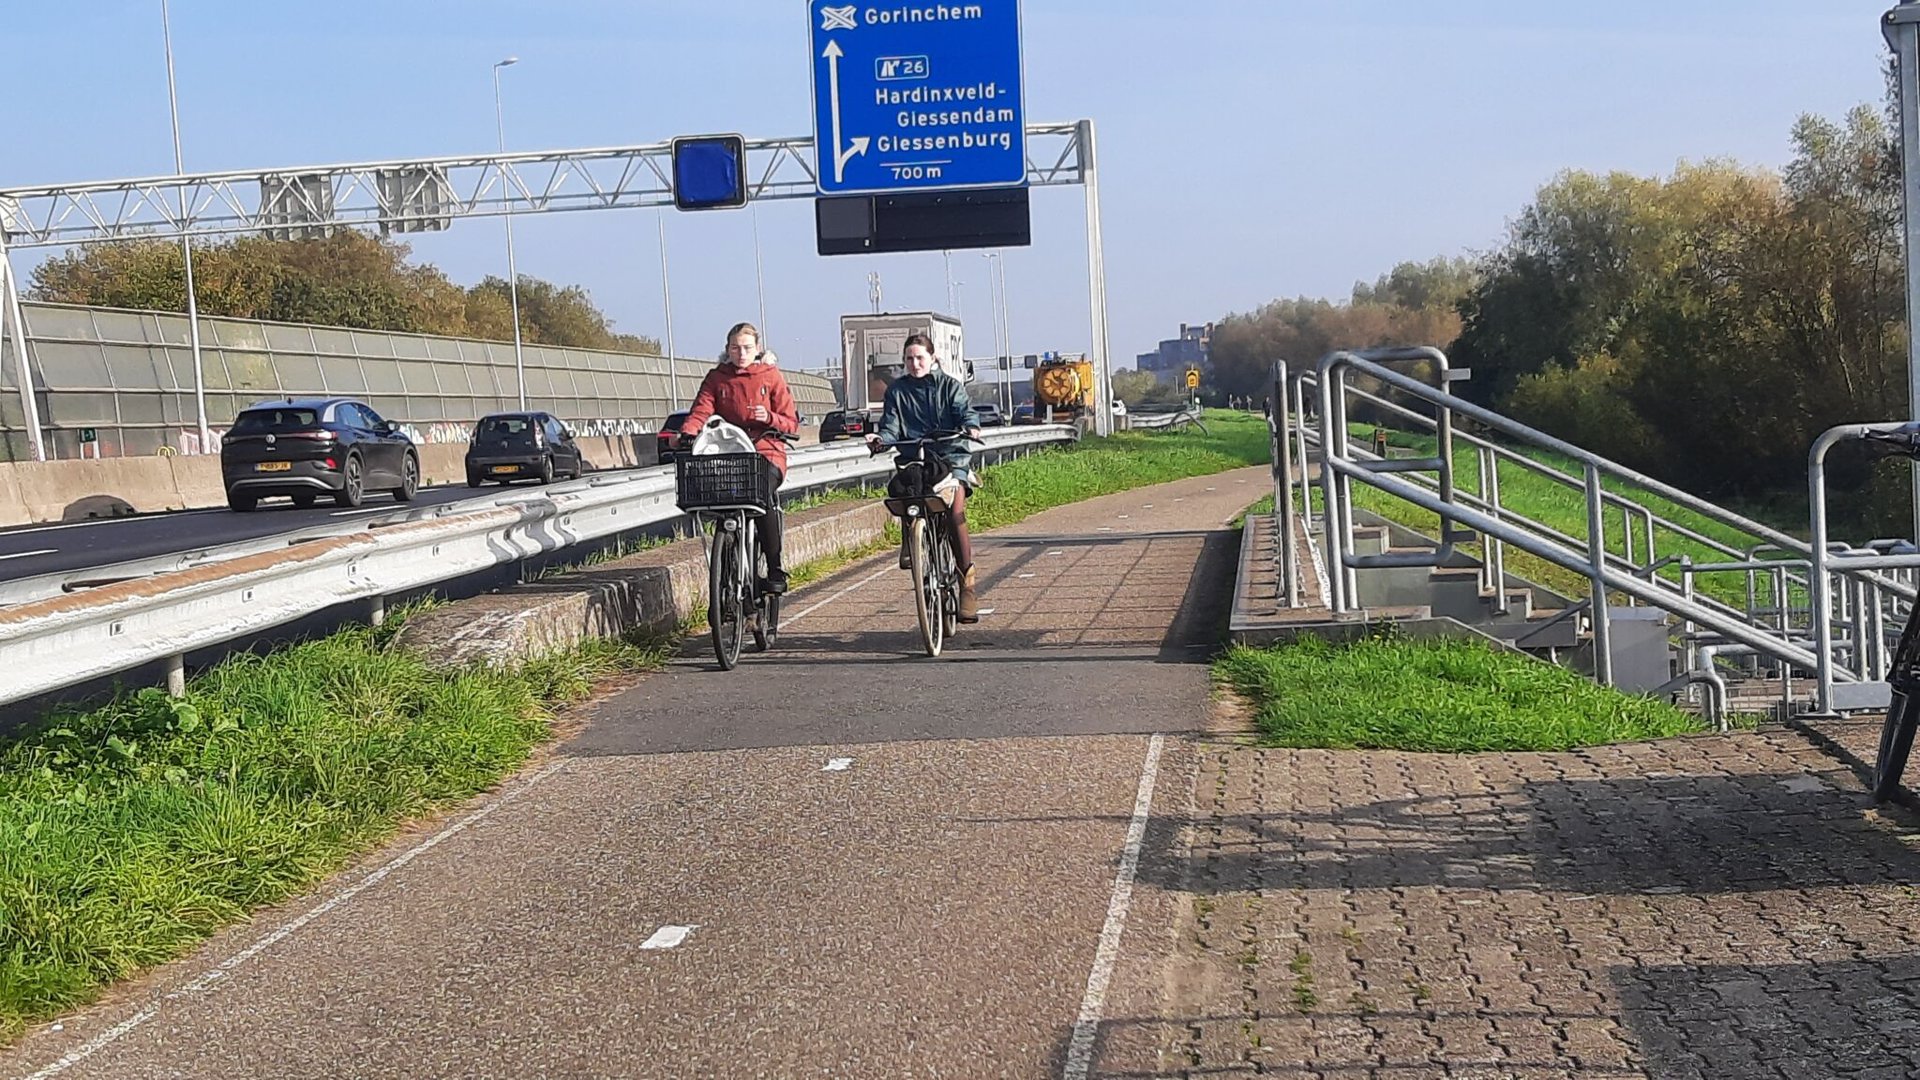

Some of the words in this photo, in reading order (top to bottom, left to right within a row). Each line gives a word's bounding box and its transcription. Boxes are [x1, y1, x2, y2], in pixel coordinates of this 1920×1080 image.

[864, 5, 982, 25] Gorinchem
[903, 60, 925, 74] 26
[875, 83, 1006, 105] Hardinxveld-
[897, 107, 1014, 127] Giessendam
[877, 132, 1011, 152] Giessenburg
[891, 167, 922, 180] 700
[926, 167, 942, 179] m
